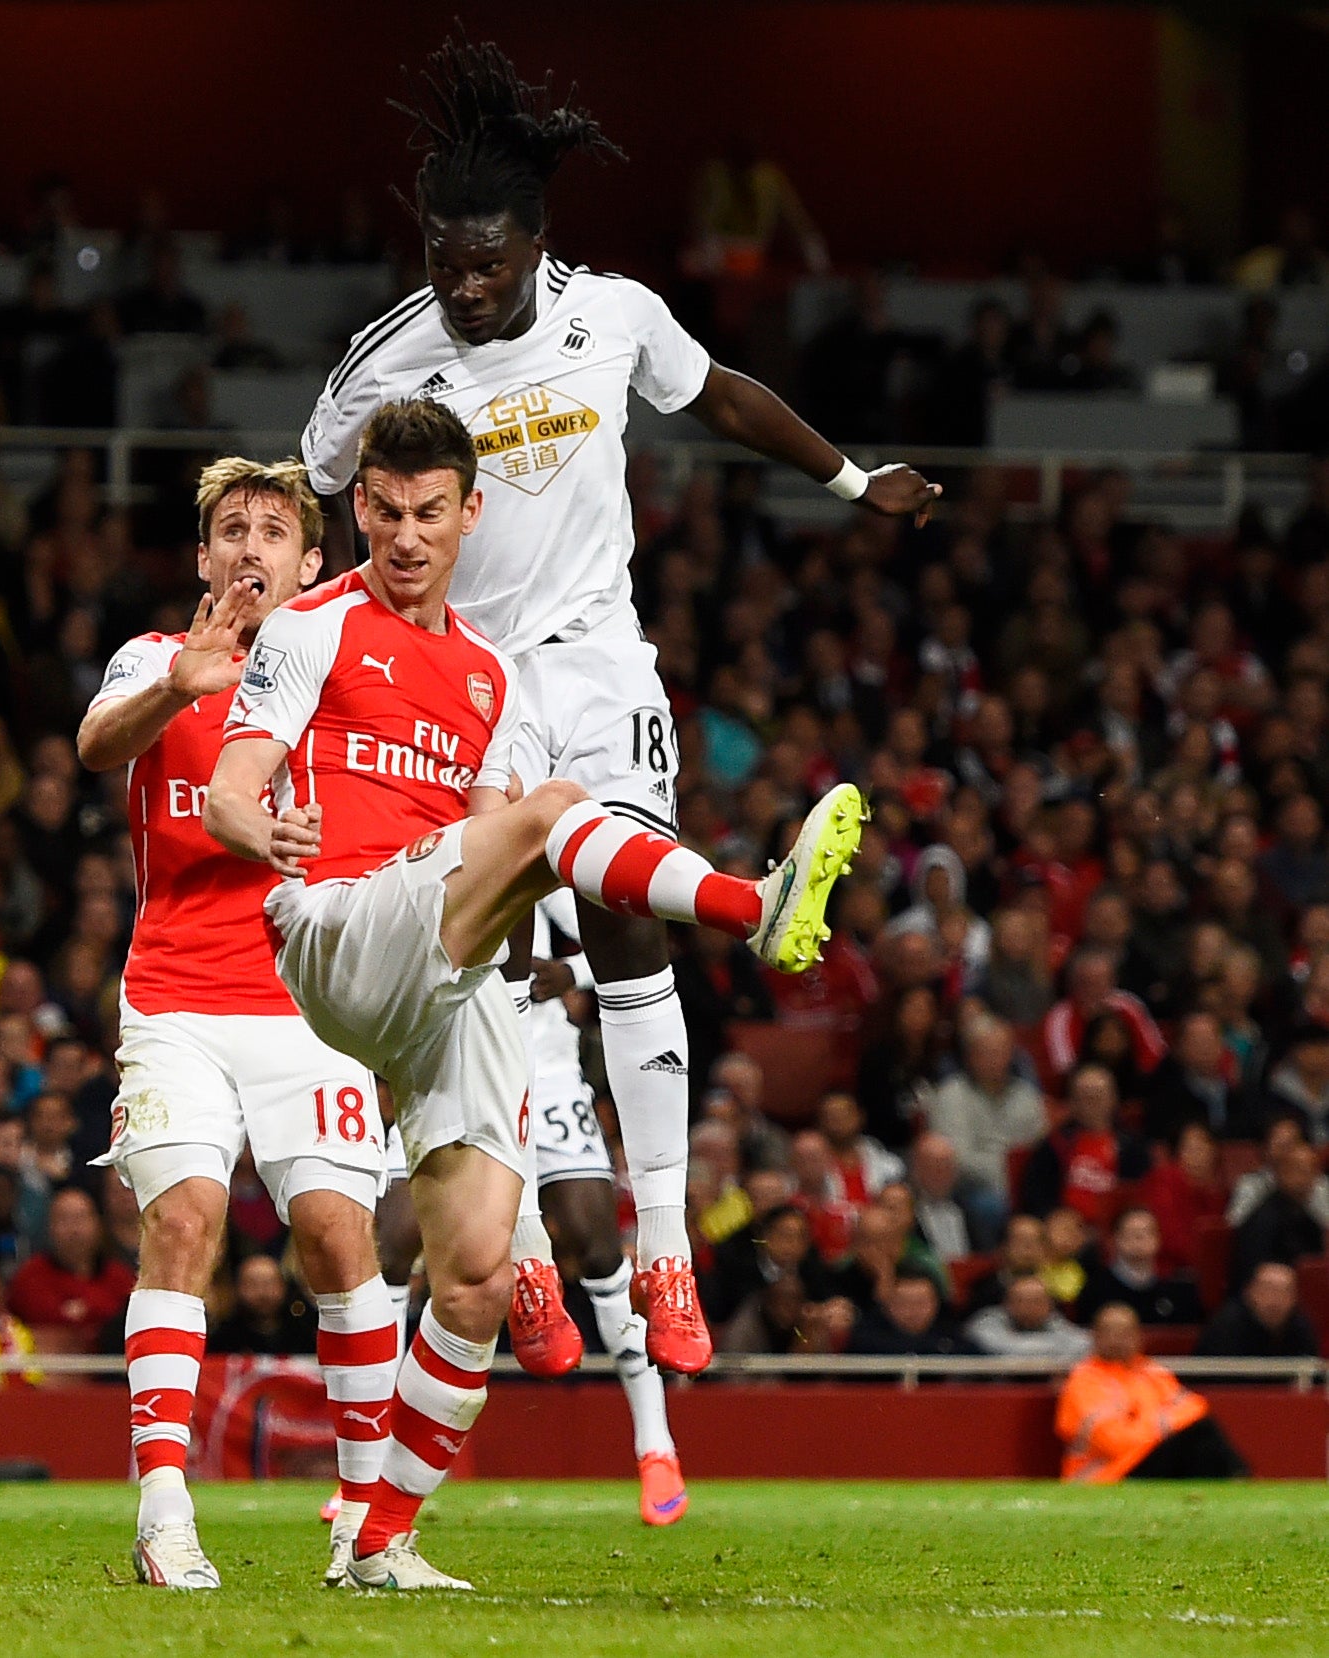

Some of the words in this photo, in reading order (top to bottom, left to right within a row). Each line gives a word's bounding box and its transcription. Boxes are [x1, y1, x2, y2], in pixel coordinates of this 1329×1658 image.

[475, 429, 520, 452] 4k.hk
[537, 413, 589, 437] GWFX
[501, 442, 560, 479] 金道
[414, 719, 460, 762] Fly
[630, 712, 669, 773] 18
[313, 1086, 366, 1144] 18
[543, 1100, 596, 1142] 58
